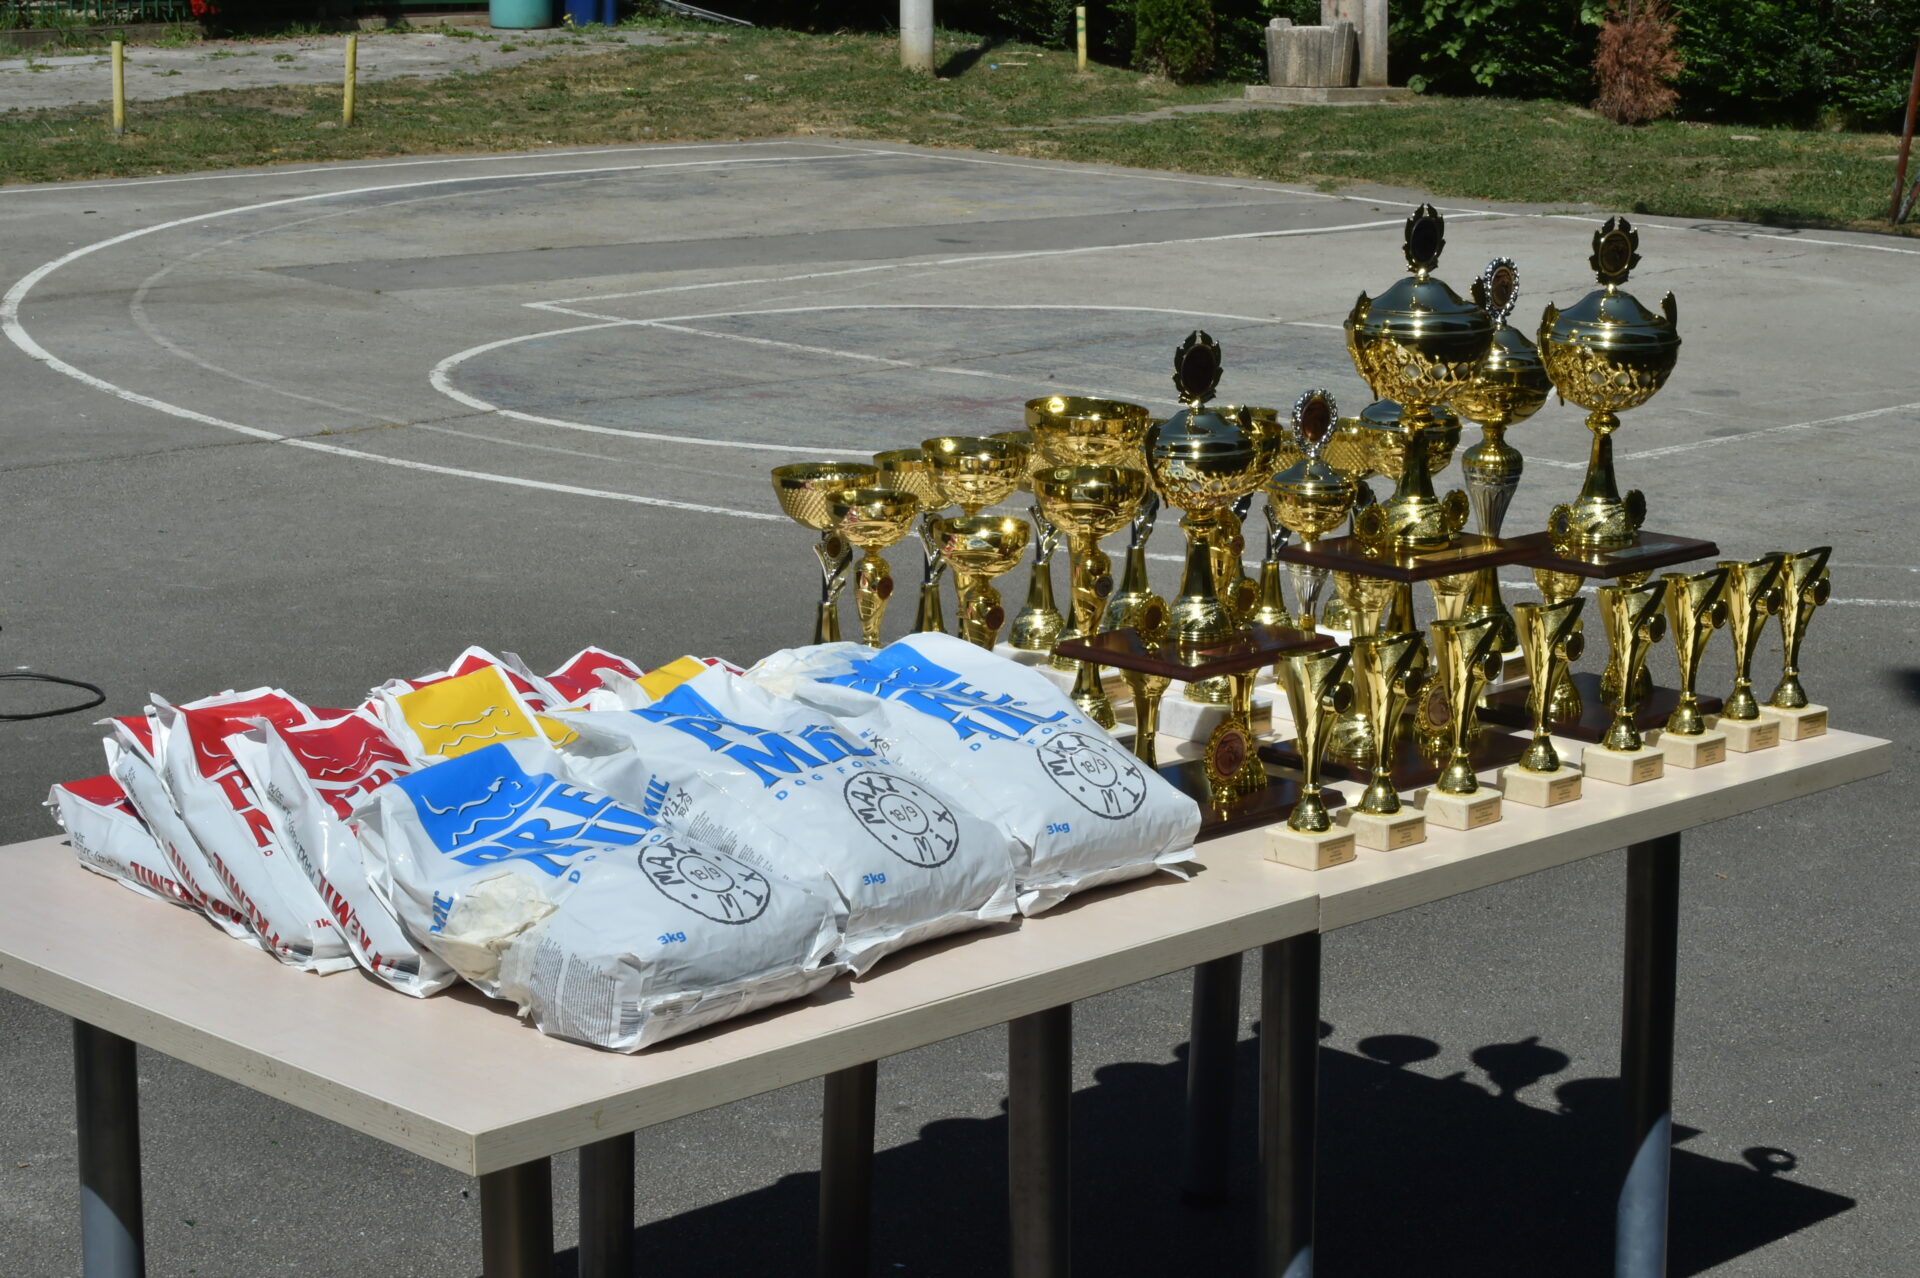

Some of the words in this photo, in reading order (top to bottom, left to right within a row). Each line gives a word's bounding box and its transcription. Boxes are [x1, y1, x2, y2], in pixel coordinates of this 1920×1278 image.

[1080, 757, 1108, 774] 18/9
[775, 773, 824, 801] DOG
[851, 776, 900, 824] MAXI
[890, 804, 918, 822] 18/9
[1046, 822, 1070, 835] 3kg
[690, 866, 721, 880] 18/9
[863, 872, 886, 885] 3kg
[657, 931, 687, 945] 3kg
